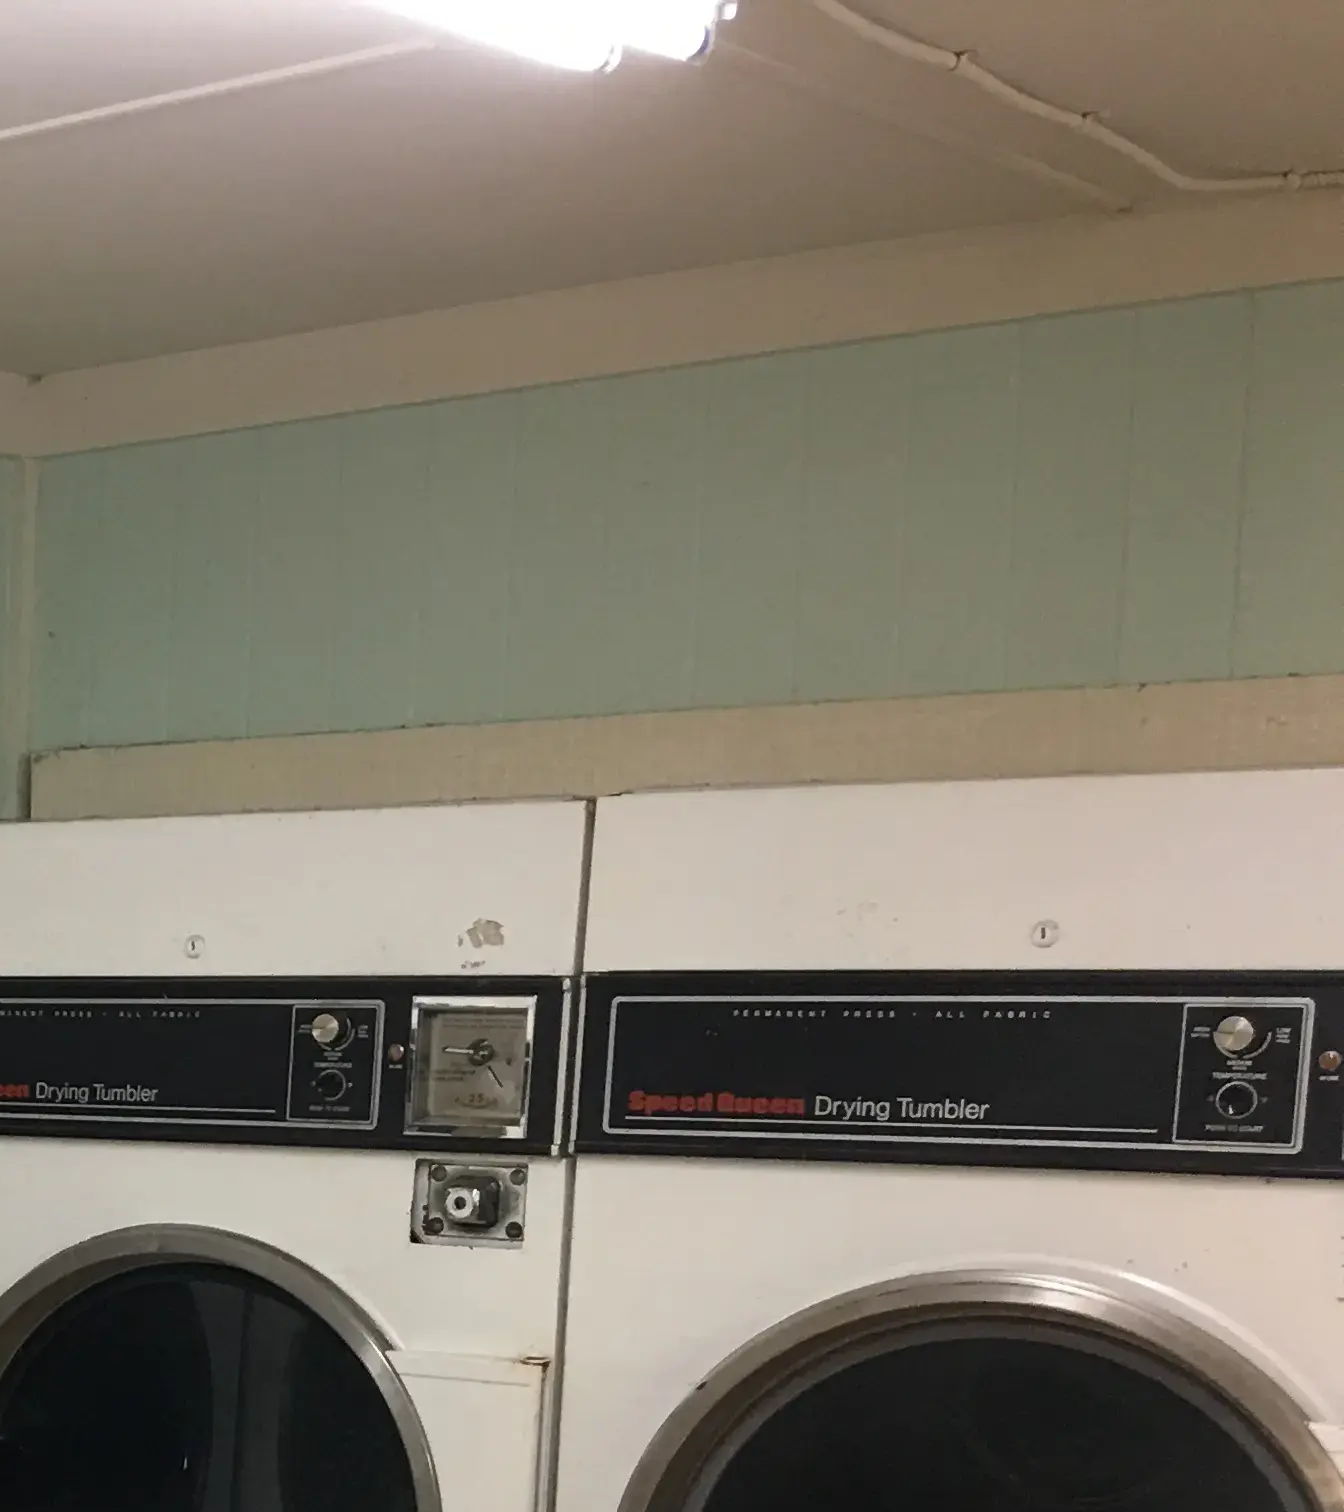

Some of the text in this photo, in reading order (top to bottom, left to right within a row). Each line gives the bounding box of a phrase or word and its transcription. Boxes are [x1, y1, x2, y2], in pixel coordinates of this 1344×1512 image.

[35, 1081, 89, 1103] Drying
[93, 1083, 158, 1102] Tumbler
[628, 1090, 990, 1121] Speed Queen Drying Tumbler
